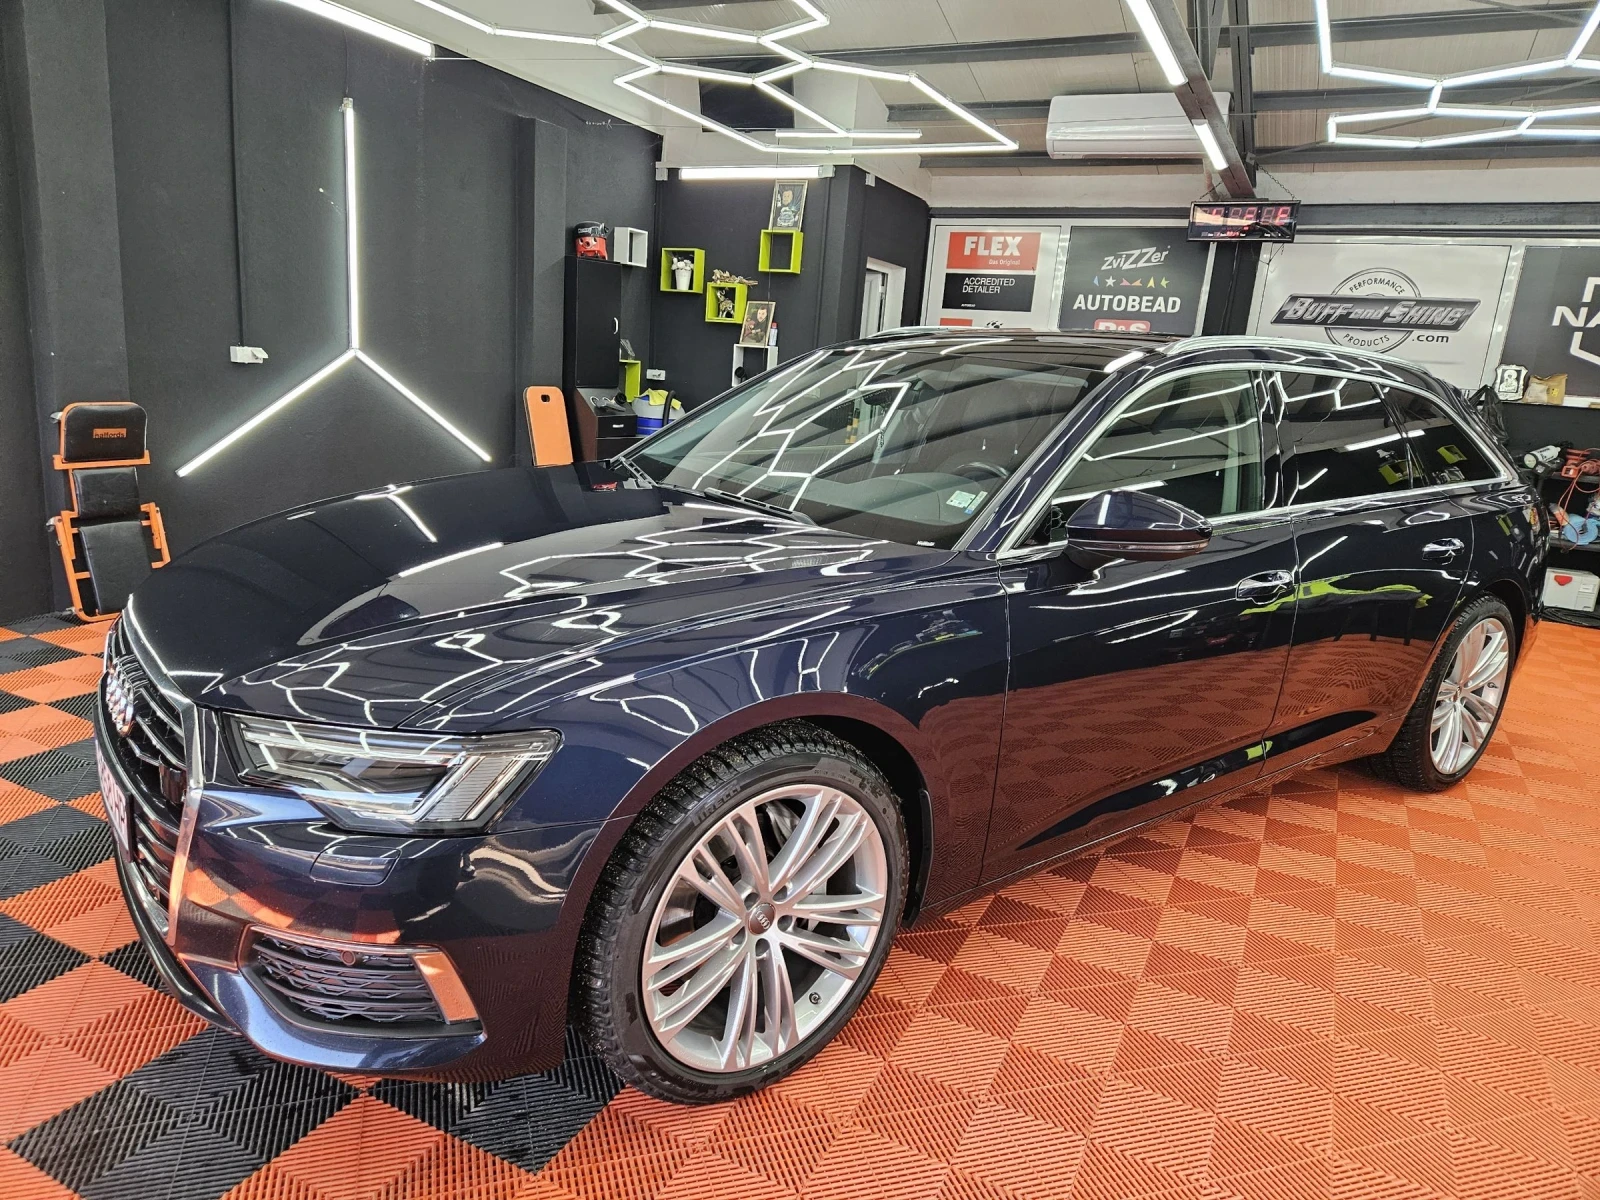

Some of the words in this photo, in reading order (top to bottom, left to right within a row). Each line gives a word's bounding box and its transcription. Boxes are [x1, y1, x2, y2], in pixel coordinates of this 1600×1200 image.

[964, 236, 1022, 256] FLEX
[962, 285, 1001, 294] DETAILER
[963, 277, 1015, 287] ACCREDITED
[1349, 277, 1405, 295] PERFORMANCE
[1072, 294, 1181, 313] AUTOBEAD
[1283, 297, 1353, 324] BUFF
[1349, 306, 1389, 320] and
[1383, 300, 1466, 325] SHINE
[1343, 333, 1390, 347] PRODUCTS
[1411, 334, 1449, 343] .com
